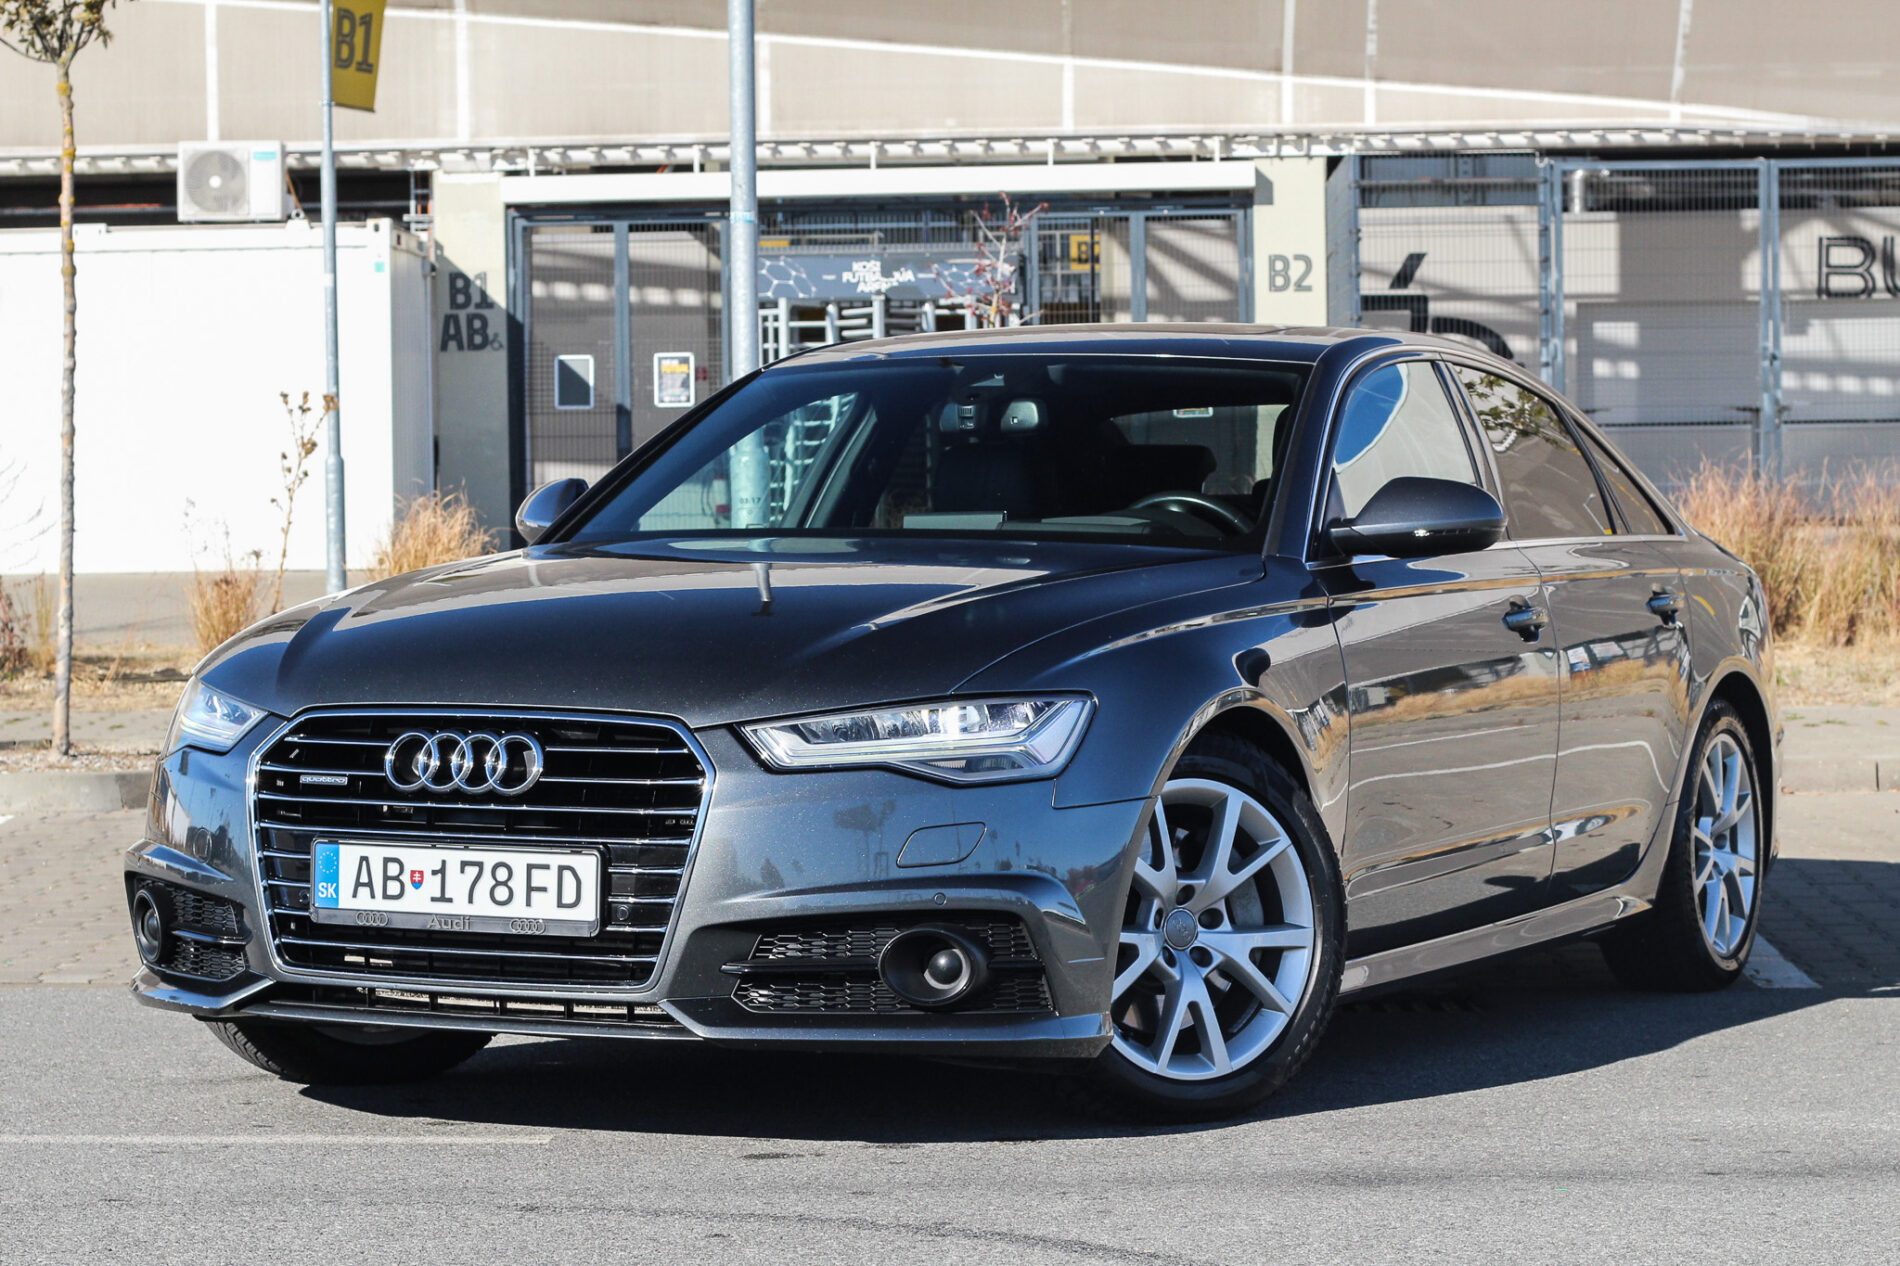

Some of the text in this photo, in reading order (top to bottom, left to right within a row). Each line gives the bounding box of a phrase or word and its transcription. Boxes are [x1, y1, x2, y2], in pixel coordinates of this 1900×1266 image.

[335, 7, 374, 74] B1
[449, 272, 494, 309] B1
[1268, 254, 1313, 292] B2
[440, 313, 489, 352] AB
[318, 882, 337, 899] SK
[351, 855, 405, 901] AB
[427, 914, 471, 931] Audi
